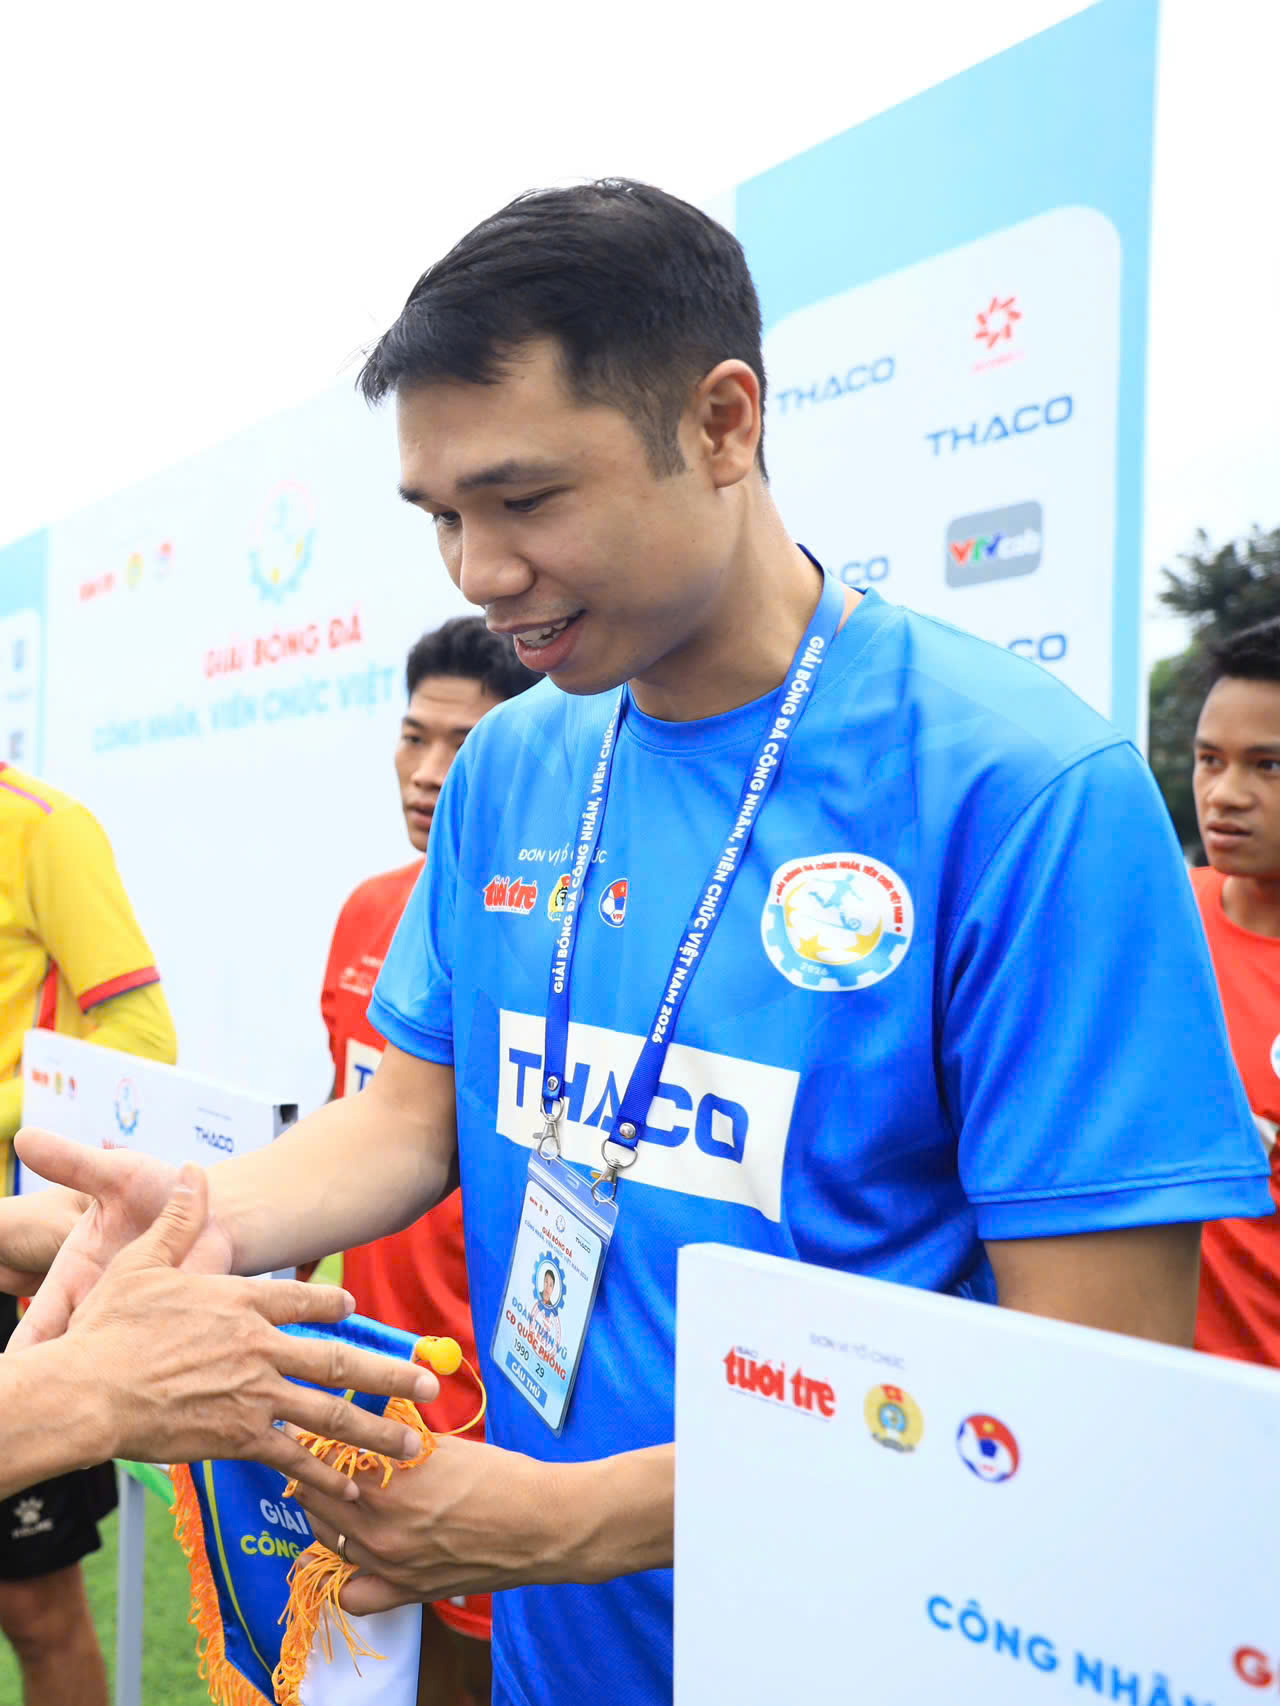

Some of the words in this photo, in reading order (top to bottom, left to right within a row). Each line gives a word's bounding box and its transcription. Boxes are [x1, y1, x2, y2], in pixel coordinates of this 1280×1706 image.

[776, 356, 896, 413] THACO
[925, 394, 1074, 456] THACO
[800, 636, 825, 669] GIẢI
[781, 669, 811, 716] BÓNG
[591, 761, 608, 795] VIÊN
[750, 742, 779, 792] CÔNG
[572, 844, 589, 888] CÔNG
[713, 847, 739, 882] VIÊN
[694, 884, 721, 930] CHỨC
[557, 914, 573, 959] BÓNG
[679, 932, 704, 968] VIỆT
[554, 961, 567, 993] GIẢI
[665, 966, 688, 1004] NAM
[652, 1004, 673, 1044] 2026
[505, 1309, 517, 1326] CĐ
[513, 1338, 530, 1361] 1990
[535, 1362, 545, 1378] 29
[723, 1345, 785, 1402] tuổi
[790, 1366, 837, 1418] trẻ
[261, 1497, 308, 1535] GIẢI
[241, 1531, 301, 1558] CÔNG
[925, 1594, 1061, 1675] CÔNG
[1072, 1651, 1220, 1706] NHÂ
